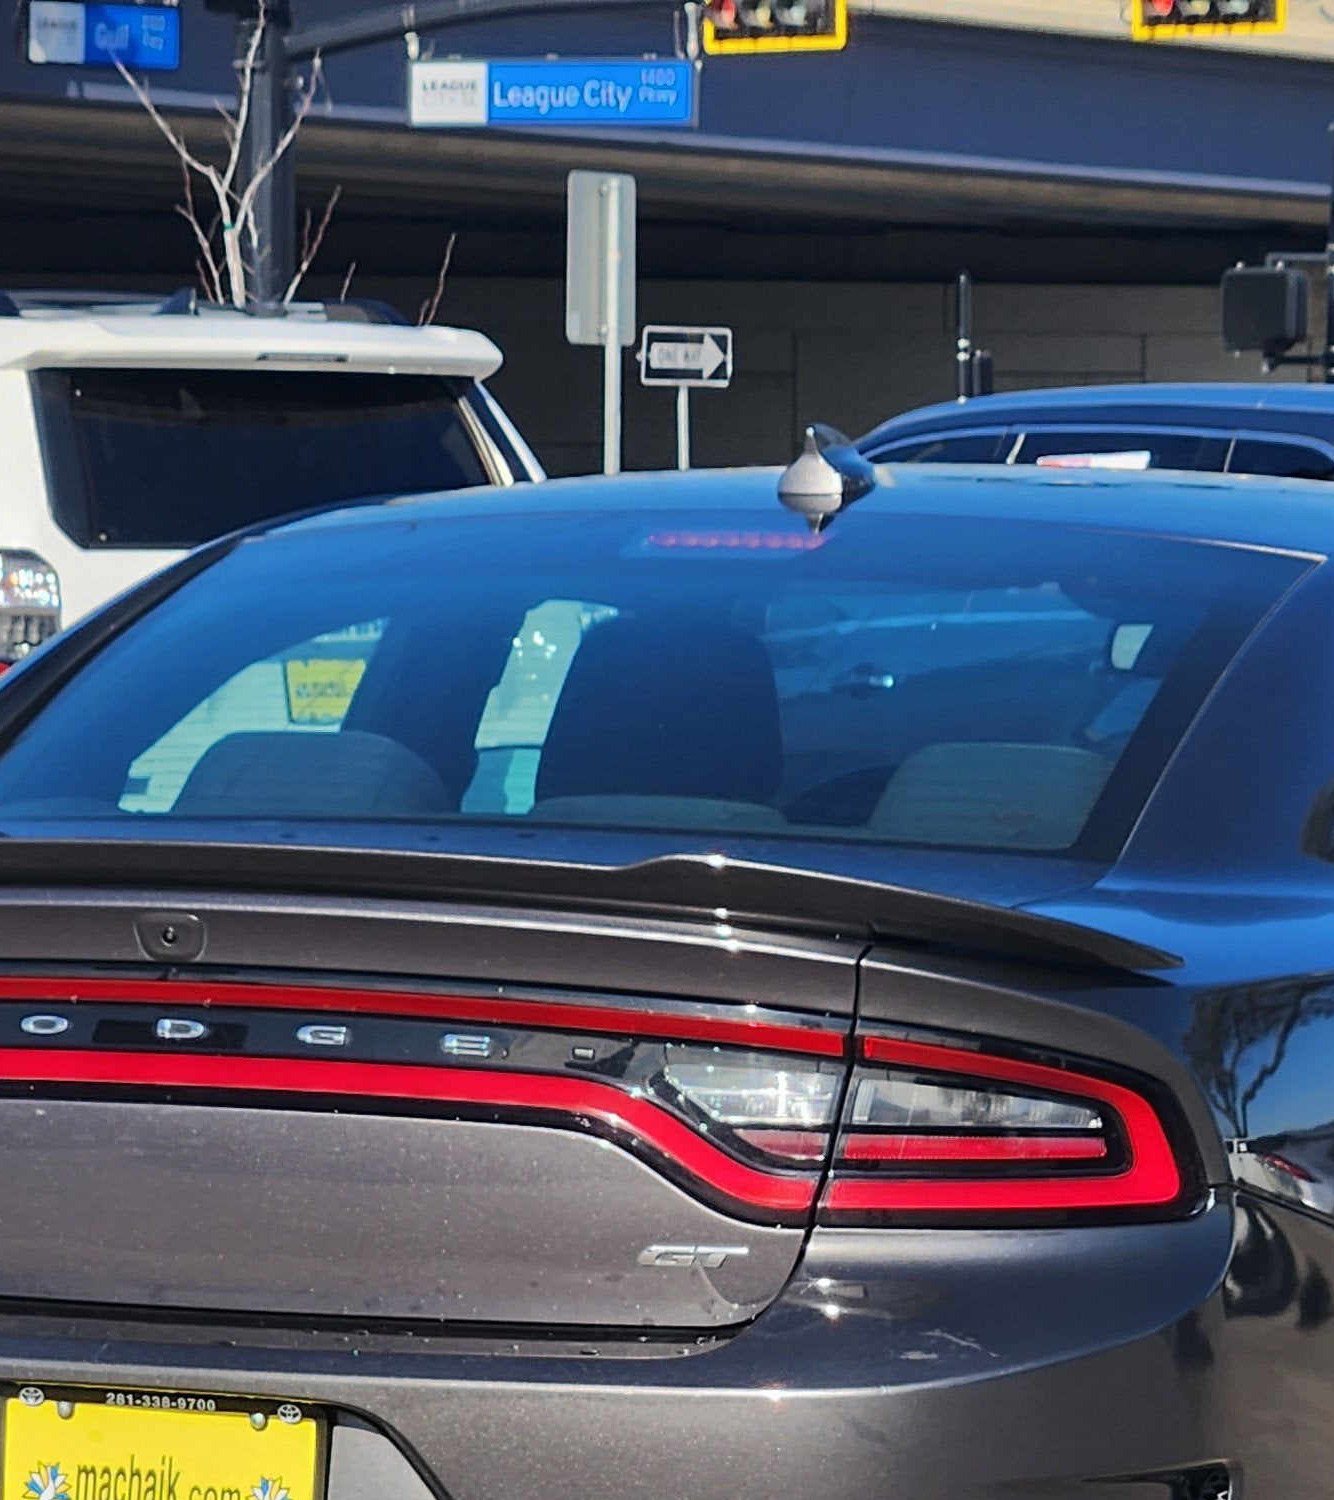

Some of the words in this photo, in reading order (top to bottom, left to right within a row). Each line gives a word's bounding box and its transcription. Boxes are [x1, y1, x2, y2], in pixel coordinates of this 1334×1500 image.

[422, 79, 478, 92] LEAGUE
[493, 80, 580, 115] League
[583, 79, 633, 113] City
[637, 1244, 750, 1269] GT
[105, 1392, 217, 1412] 281-338-9700
